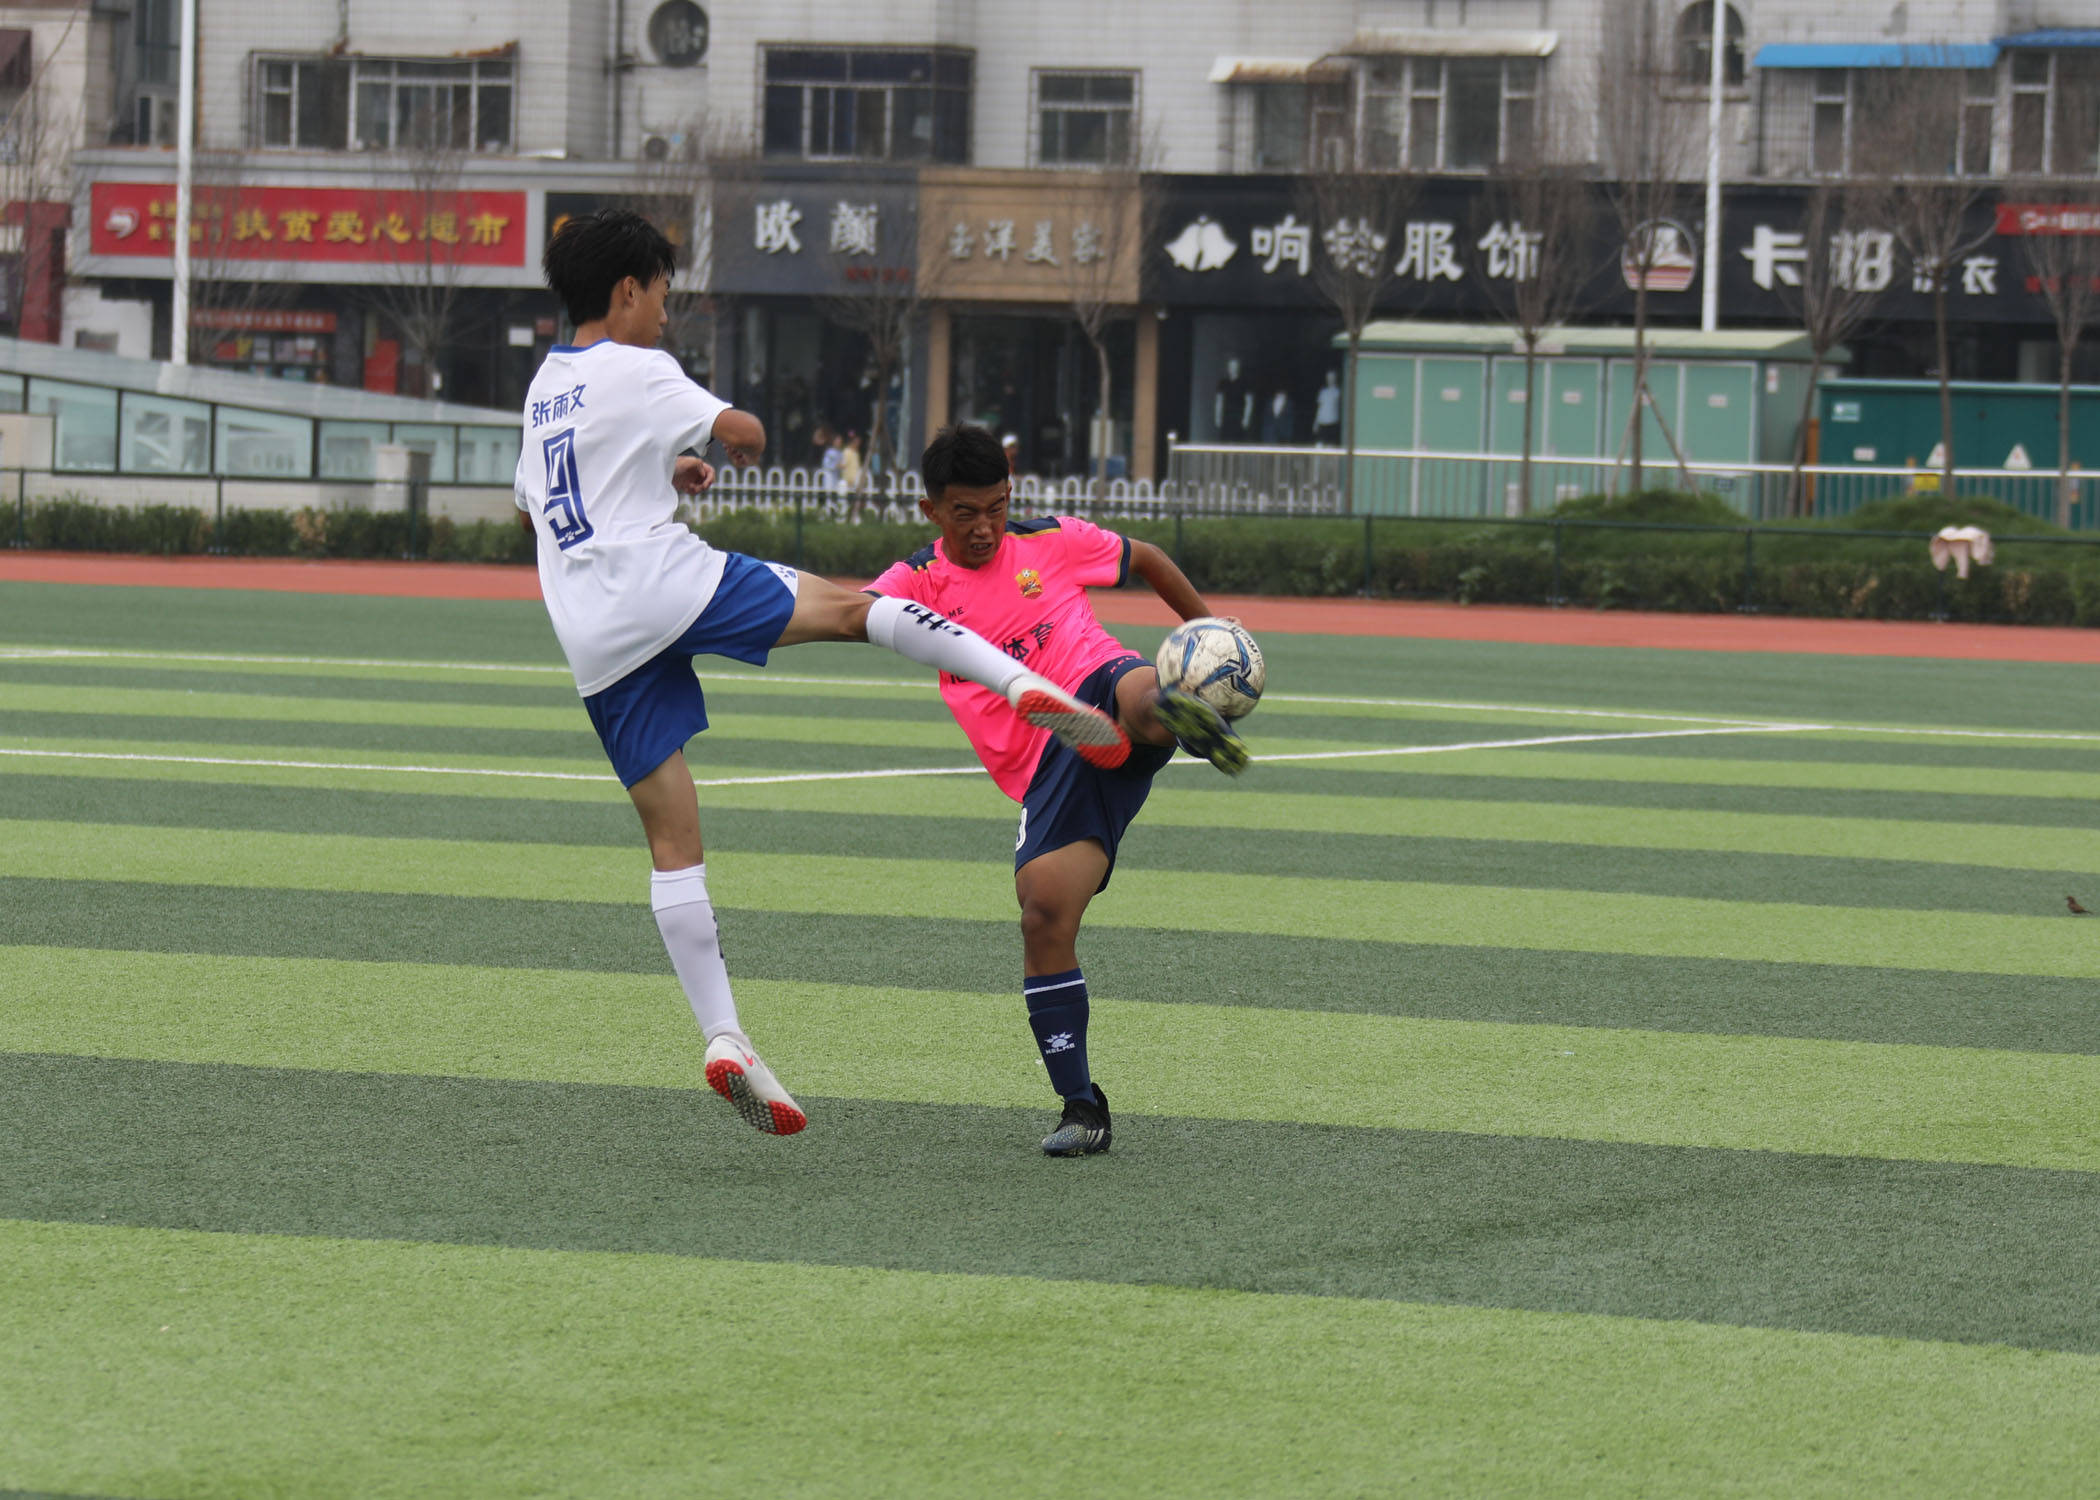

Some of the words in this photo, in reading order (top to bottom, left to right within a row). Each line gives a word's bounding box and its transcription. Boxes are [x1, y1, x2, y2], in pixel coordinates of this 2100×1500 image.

[232, 208, 509, 246] 扶贫爱心超市
[754, 200, 878, 256] 欧颜
[1250, 214, 1543, 283] 响铃服饰
[532, 384, 587, 428] 张雨文
[543, 427, 594, 552] 9
